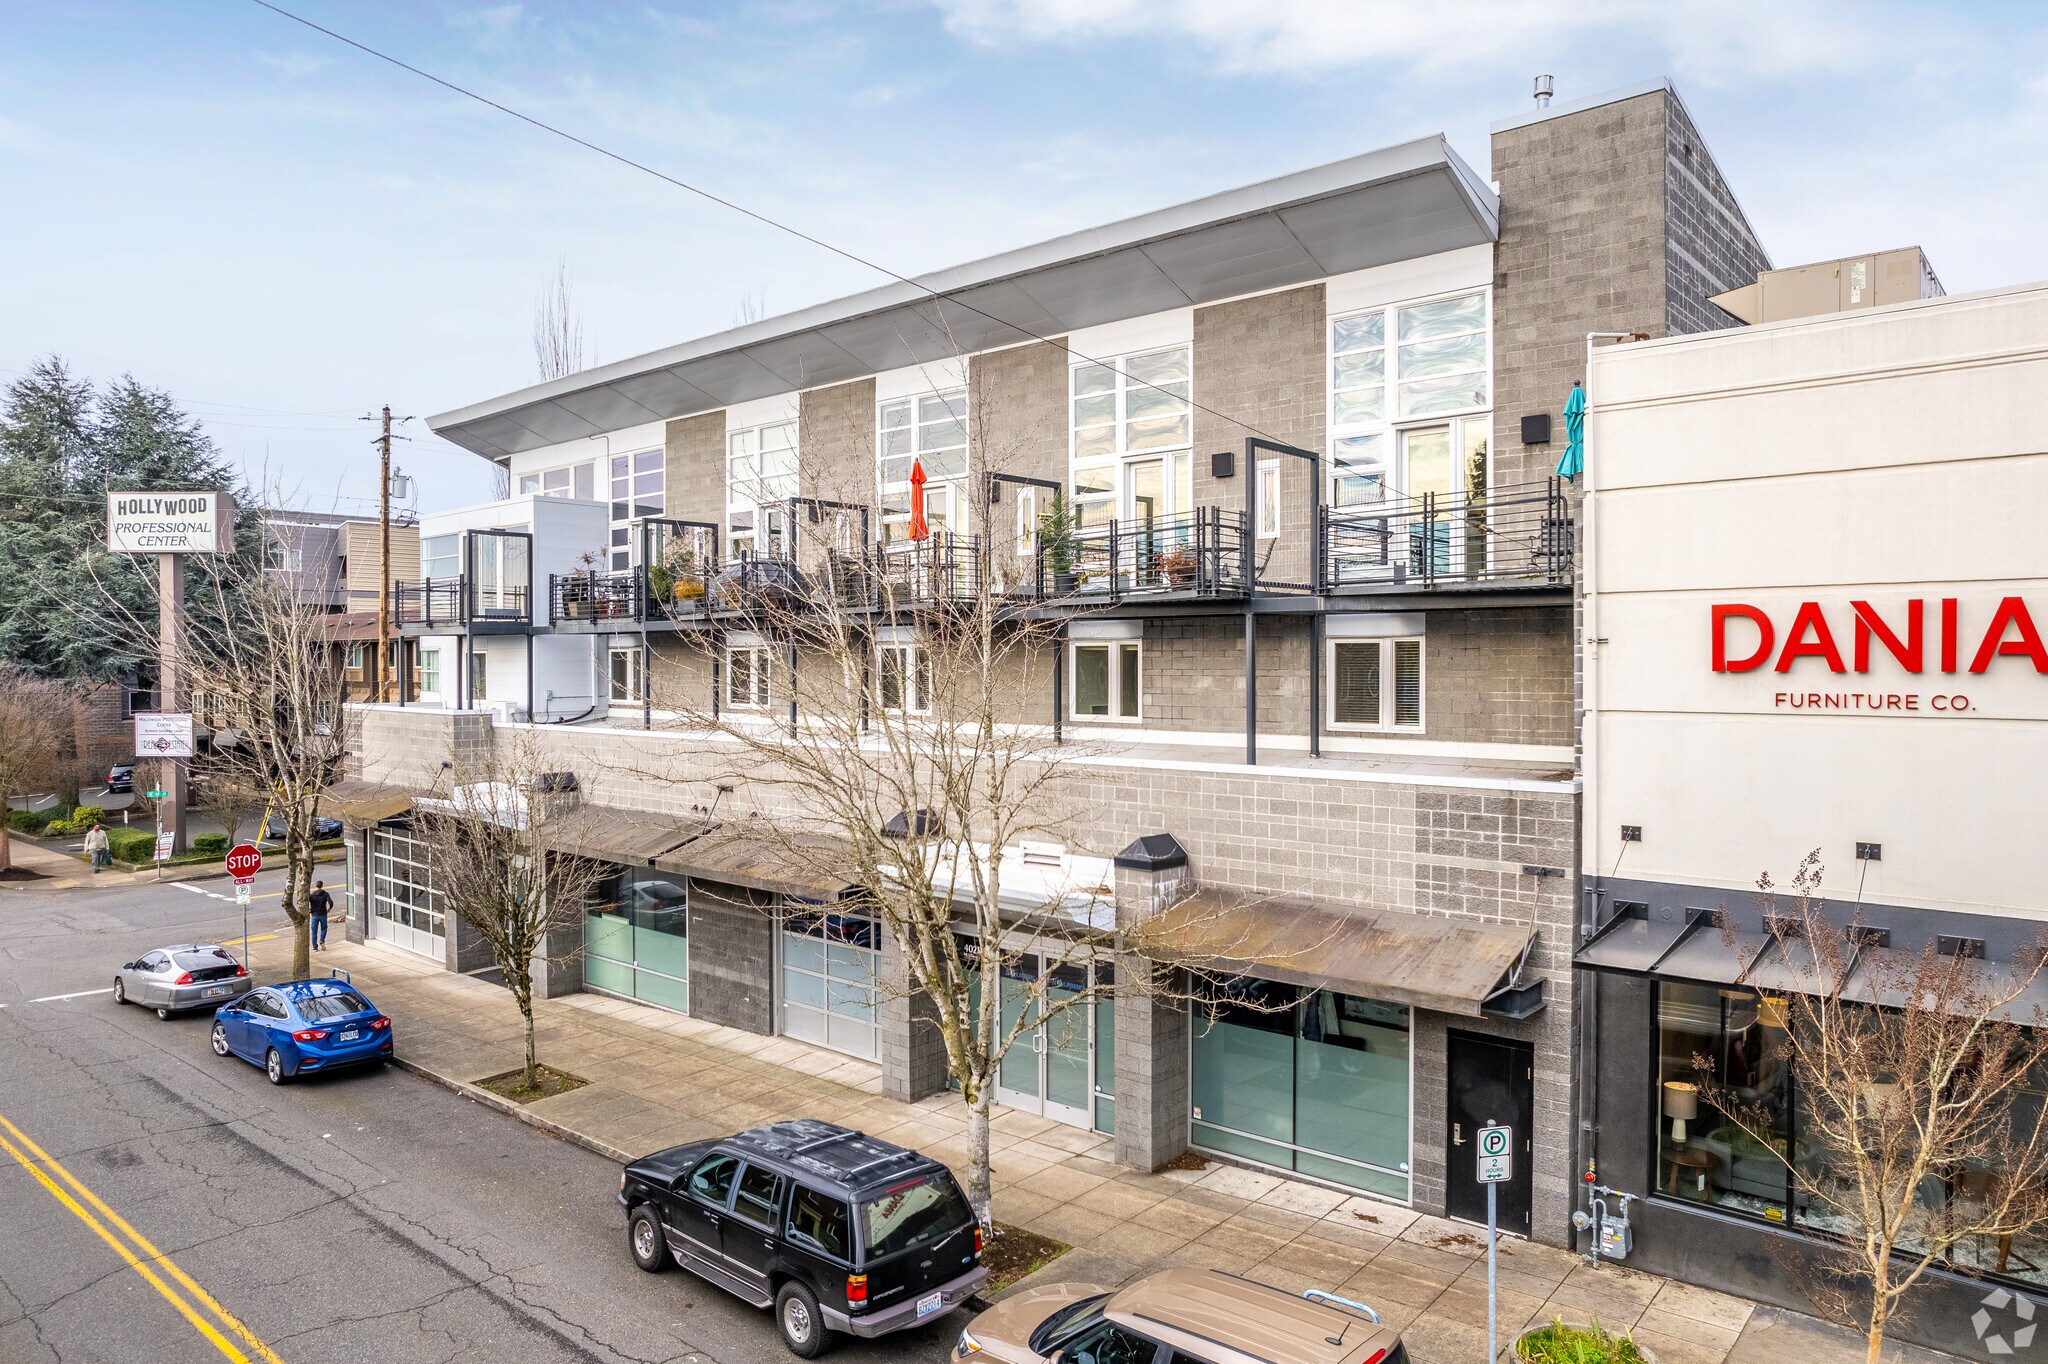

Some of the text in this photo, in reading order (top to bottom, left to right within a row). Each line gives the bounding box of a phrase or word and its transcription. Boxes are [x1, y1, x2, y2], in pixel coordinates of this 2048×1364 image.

[118, 498, 207, 515] HOLLYWOOD
[115, 522, 211, 533] PROFESSIONAL
[137, 535, 187, 546] CENTER
[1711, 596, 2048, 673] DANIA
[1775, 692, 1976, 711] FURNITURE CO.
[229, 854, 260, 869] STOP
[1490, 1135, 1501, 1150] P
[1492, 1158, 1498, 1167] 2
